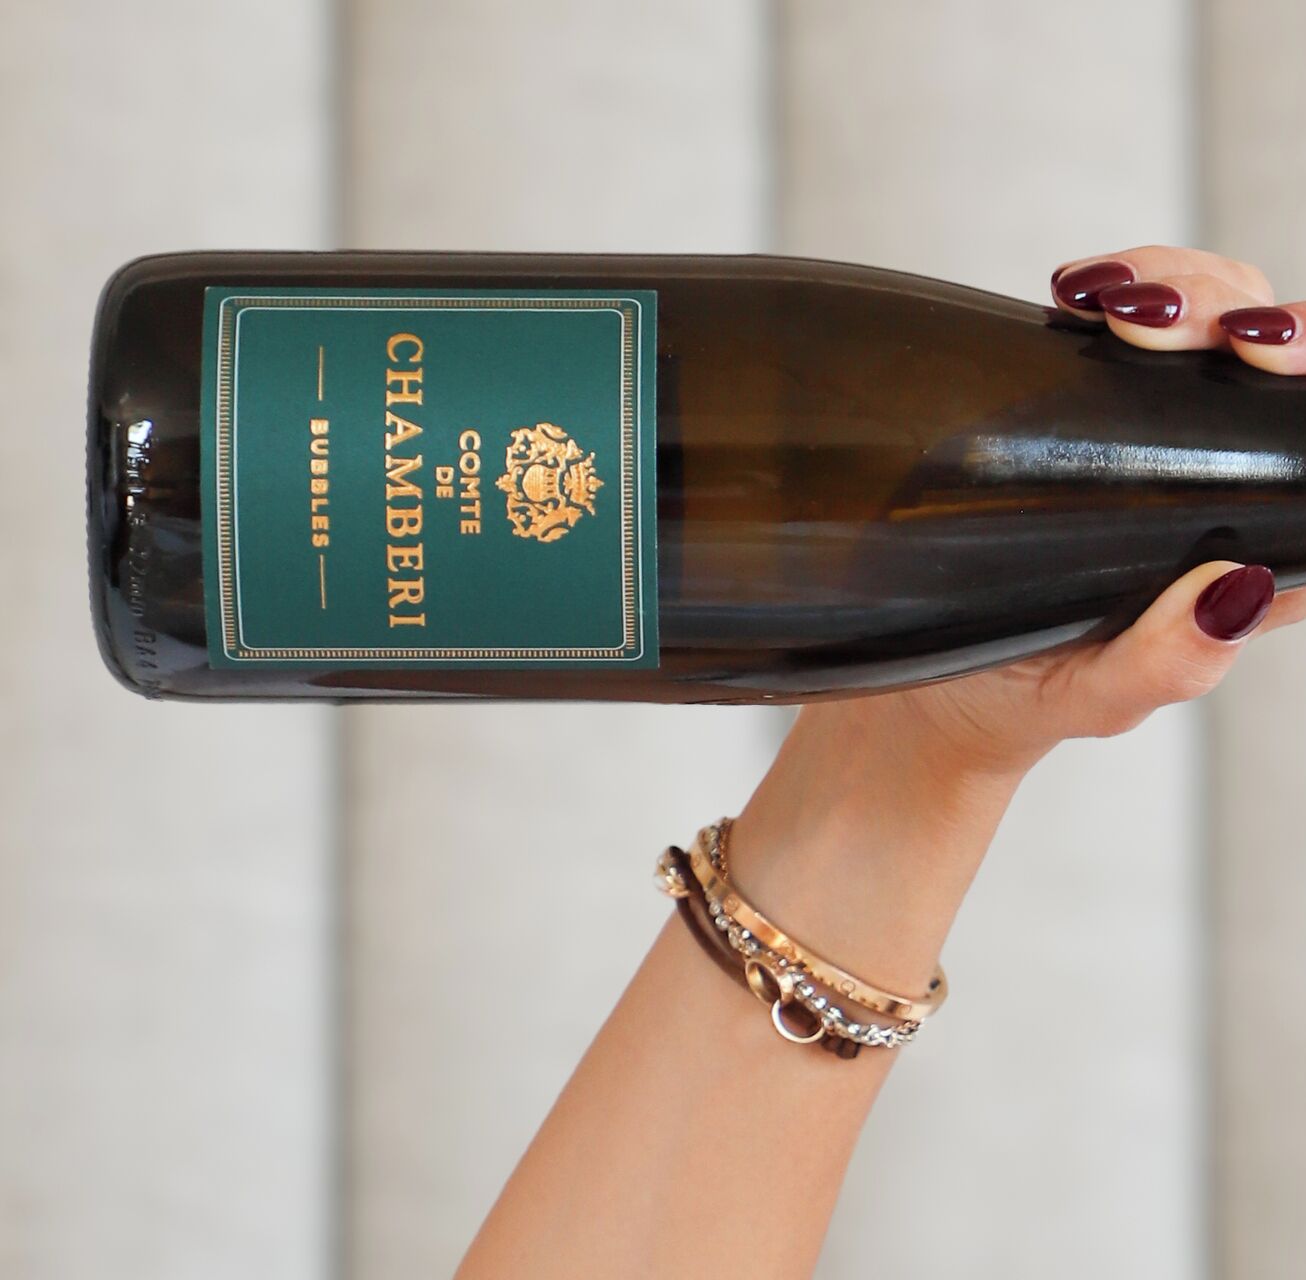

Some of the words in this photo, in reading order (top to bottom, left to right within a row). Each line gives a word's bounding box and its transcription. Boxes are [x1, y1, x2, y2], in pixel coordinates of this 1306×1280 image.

[309, 418, 330, 548] BUBBLES
[383, 332, 427, 628] CHAMBERI
[435, 464, 455, 499] DE
[458, 428, 482, 535] COMTE
